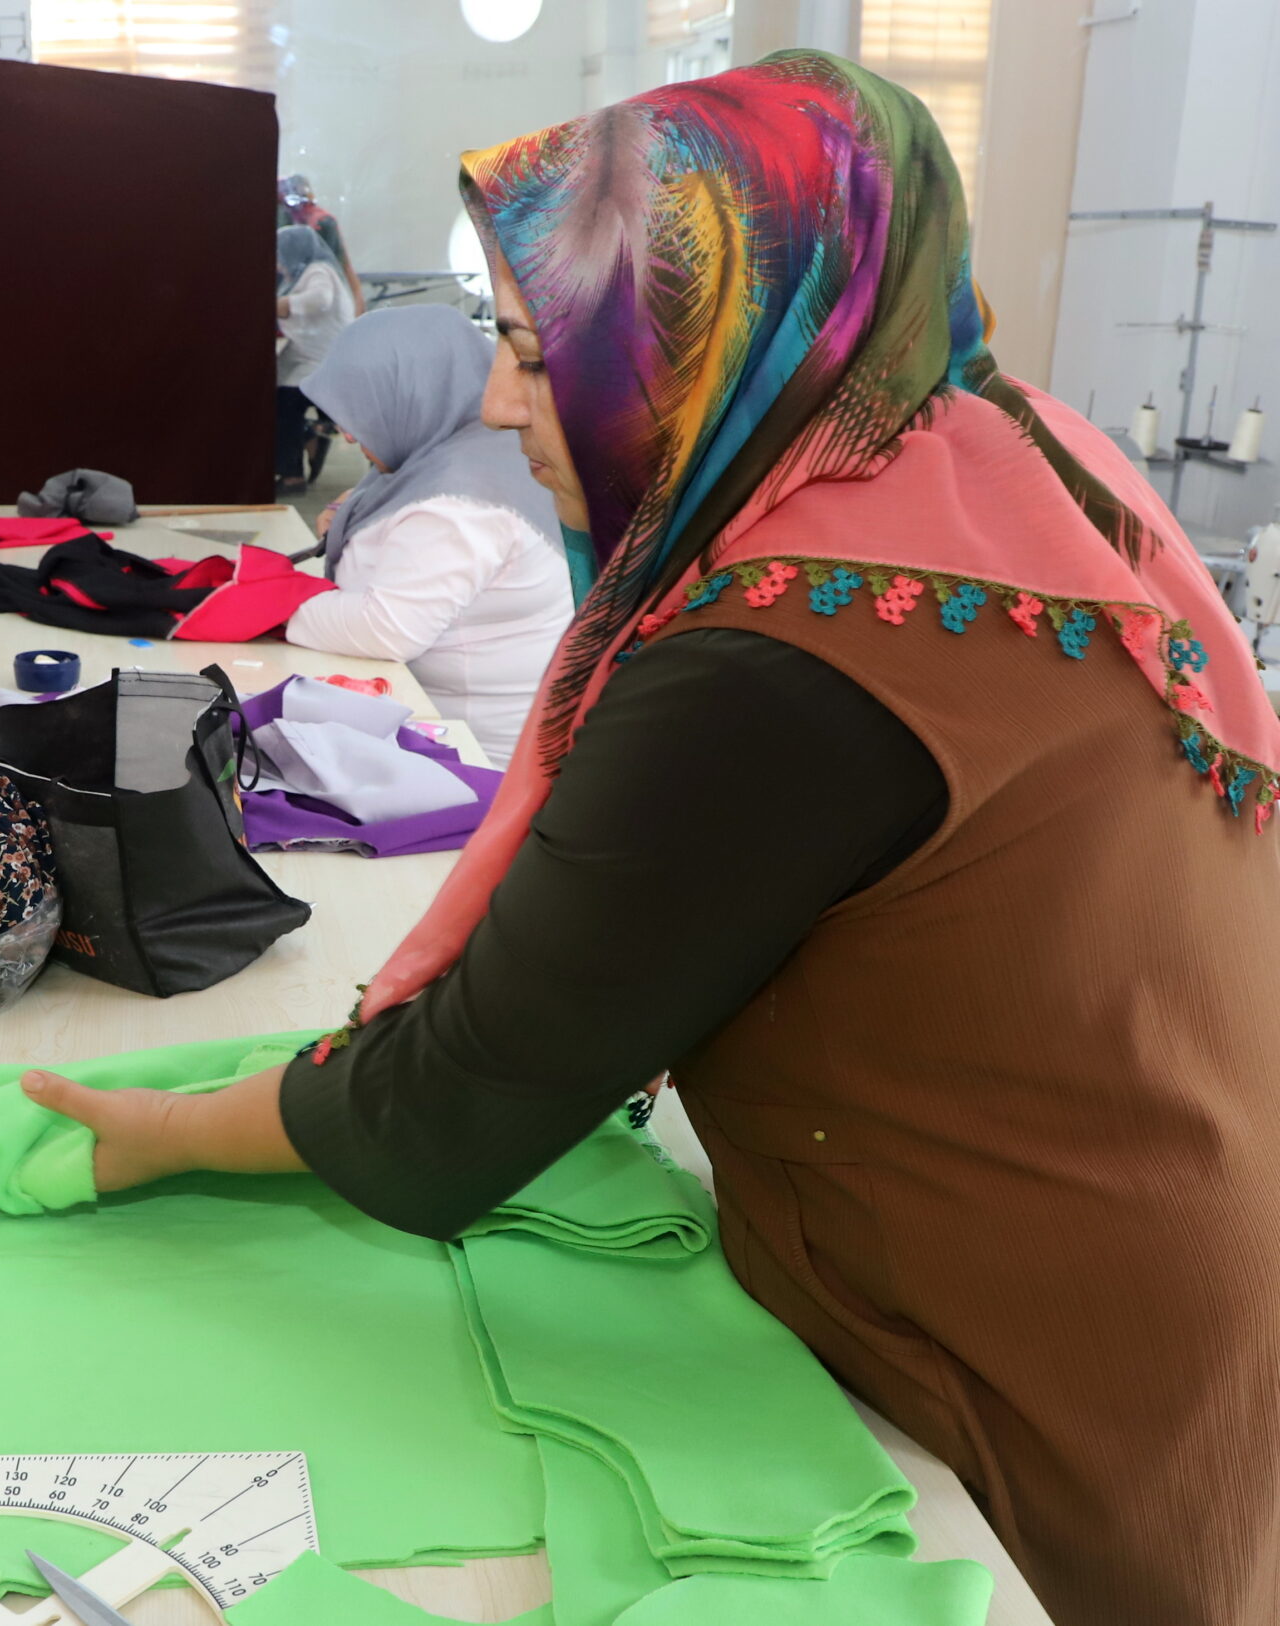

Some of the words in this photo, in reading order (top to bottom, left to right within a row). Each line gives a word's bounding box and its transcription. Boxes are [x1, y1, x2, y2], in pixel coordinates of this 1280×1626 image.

[5, 1471, 28, 1481] 130
[266, 1469, 278, 1478] 0
[53, 1475, 77, 1487] 120
[251, 1476, 269, 1488] 90
[4, 1486, 21, 1496] 50
[49, 1490, 66, 1501] 60
[99, 1484, 124, 1498] 110
[91, 1499, 110, 1510] 70
[143, 1498, 167, 1513] 100
[130, 1513, 149, 1525] 80
[220, 1543, 239, 1557] 80
[198, 1551, 221, 1569] 100
[248, 1572, 268, 1586] 70
[224, 1578, 247, 1597] 110
